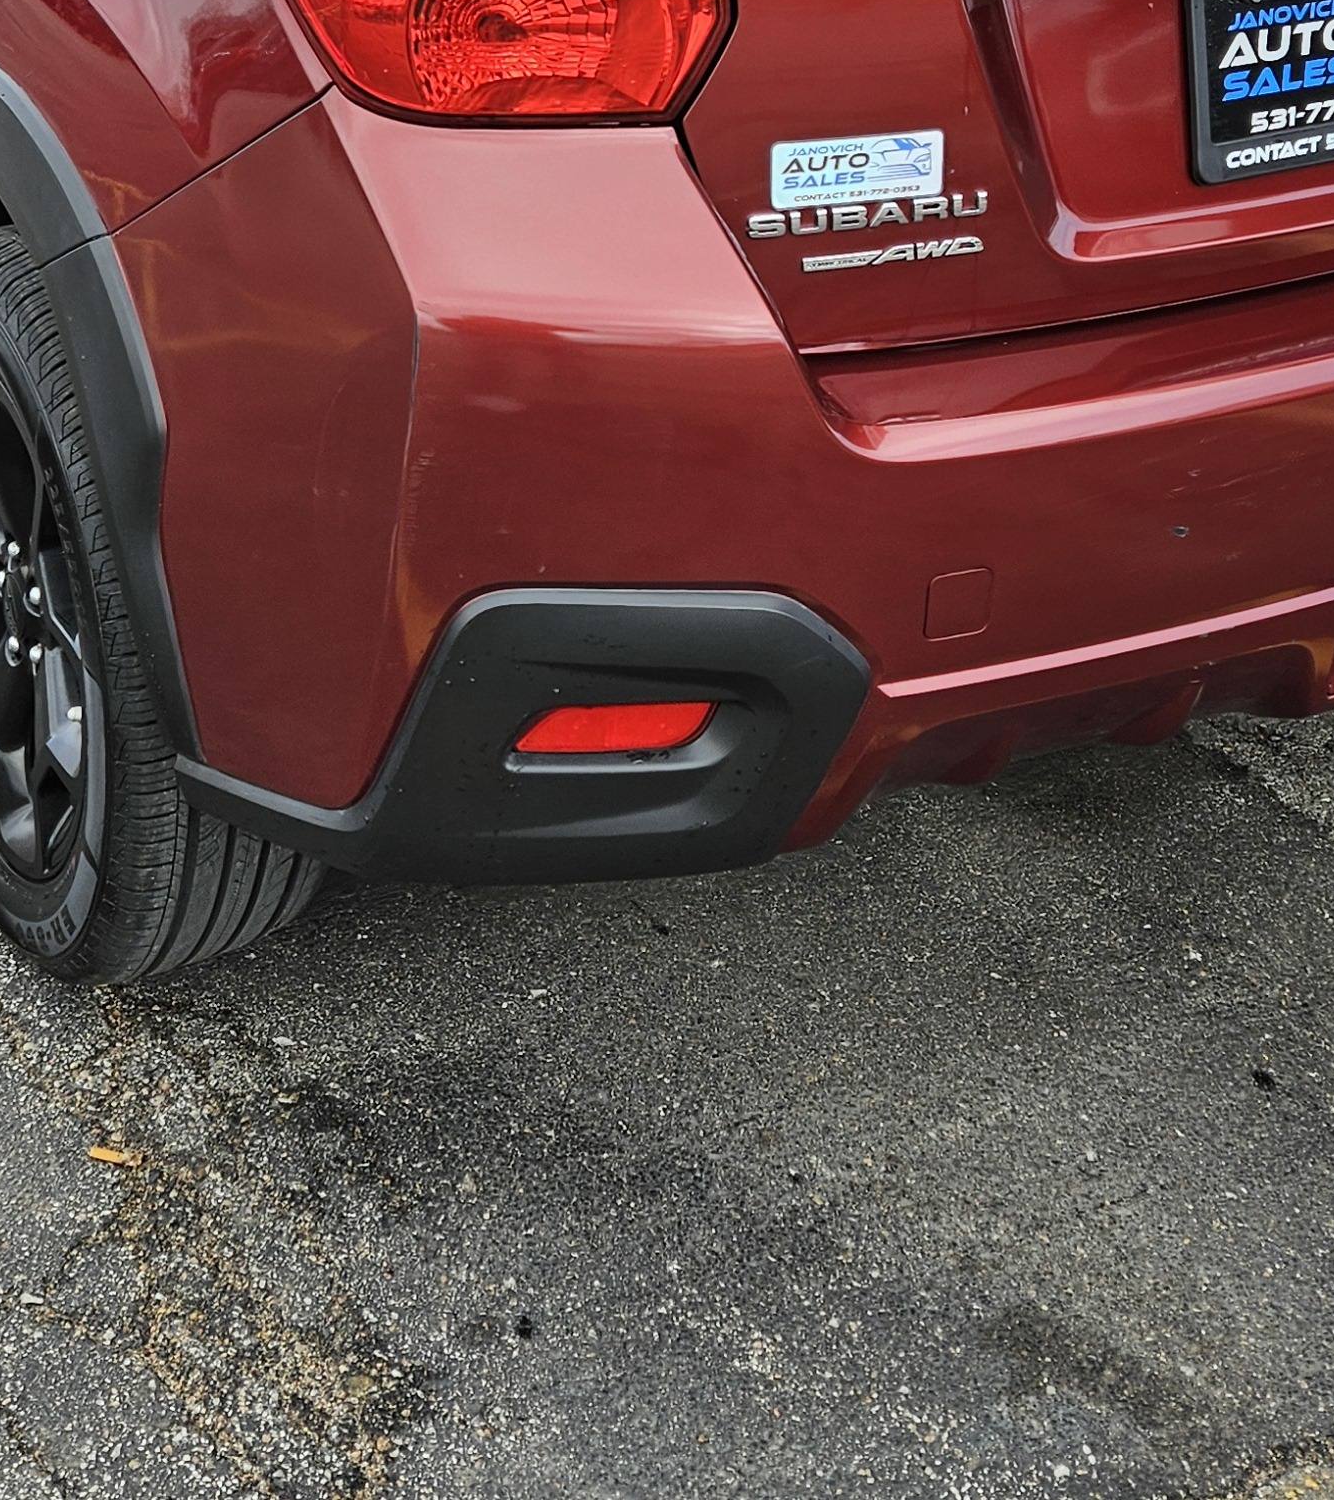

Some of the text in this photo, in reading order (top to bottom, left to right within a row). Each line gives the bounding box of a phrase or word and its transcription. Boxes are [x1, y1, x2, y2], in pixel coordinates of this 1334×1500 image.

[788, 143, 864, 157] JANOVICH
[1226, 134, 1322, 170] CONTACT
[782, 152, 870, 175] AUTO
[782, 170, 865, 190] SALES
[794, 184, 921, 203] CONTACT 531-772-0353
[747, 190, 988, 239] SUBARU
[871, 236, 985, 266] AWD
